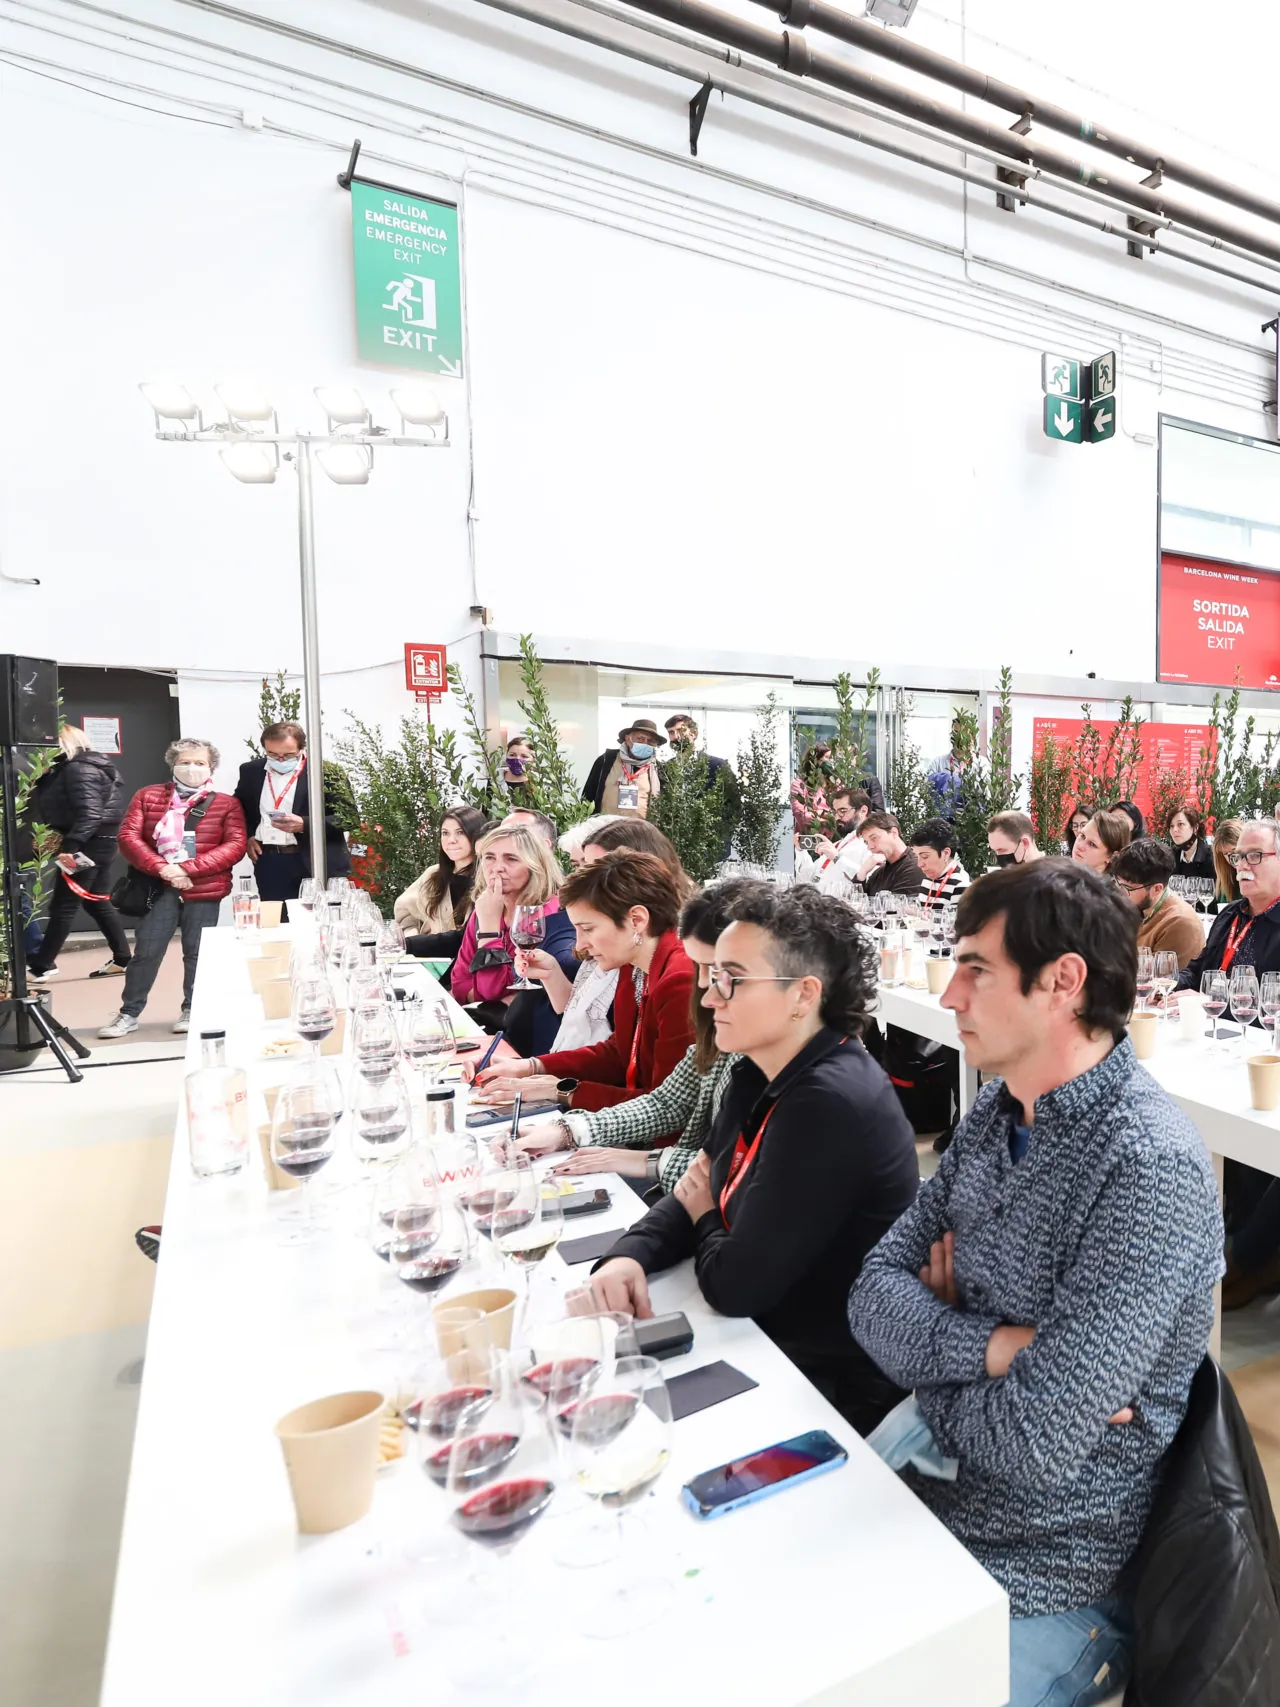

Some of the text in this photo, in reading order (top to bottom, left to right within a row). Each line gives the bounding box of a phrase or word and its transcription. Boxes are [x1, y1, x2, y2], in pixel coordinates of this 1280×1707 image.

[383, 199, 429, 222] SALIDA
[365, 209, 448, 241] EMERGENCIA
[366, 226, 447, 256] EMERGENCY
[393, 248, 422, 265] EXIT
[383, 325, 438, 352] EXIT
[1184, 567, 1259, 585] BARCELONA WINE WEEK
[1192, 599, 1250, 619] SORTIDA
[1197, 617, 1245, 635] SALIDA
[1207, 635, 1236, 650] EXIT
